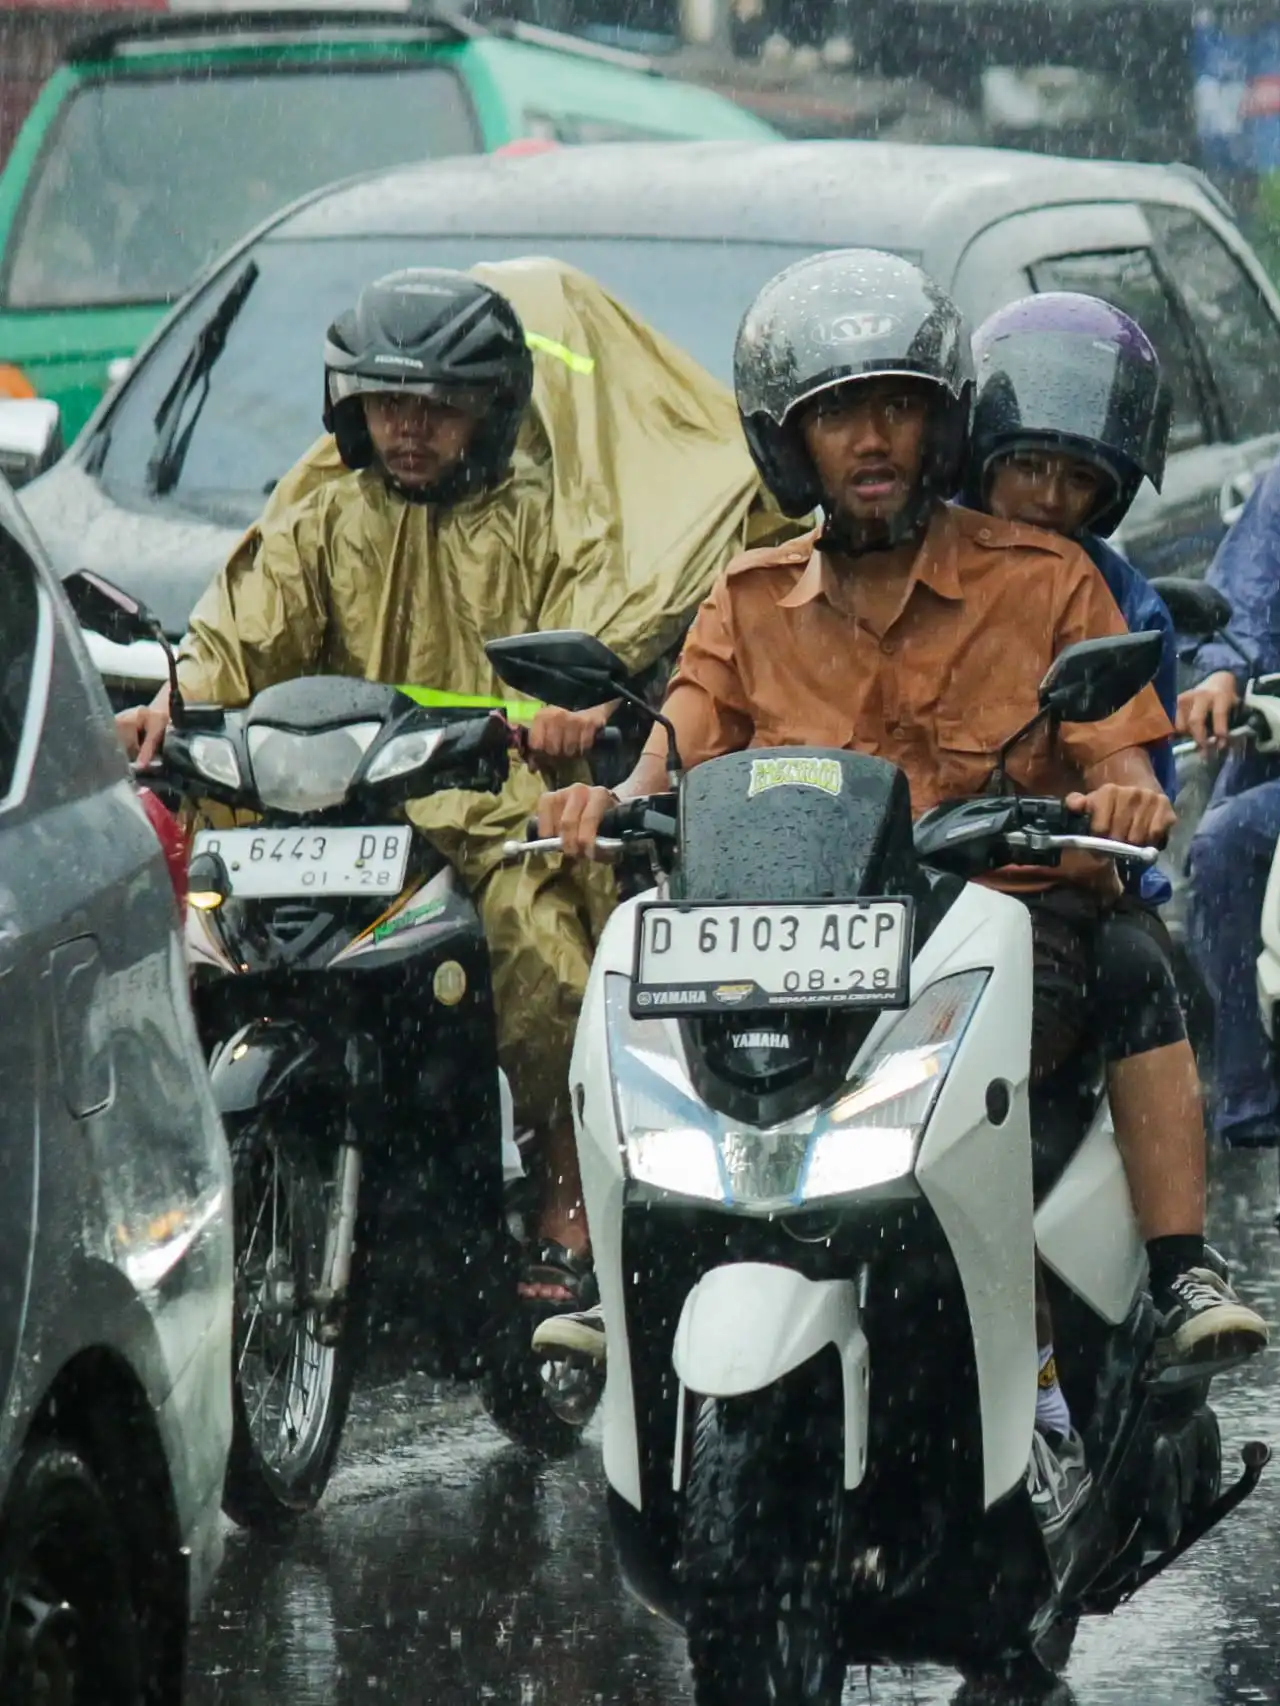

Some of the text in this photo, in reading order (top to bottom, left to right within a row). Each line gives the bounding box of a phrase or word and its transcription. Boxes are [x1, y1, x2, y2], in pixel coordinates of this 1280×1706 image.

[249, 836, 327, 861] 6443
[359, 834, 399, 860] DB
[650, 912, 895, 954] D 6103 ACP
[652, 990, 707, 1004] YAMAHA
[732, 1031, 790, 1049] YAMAHA
